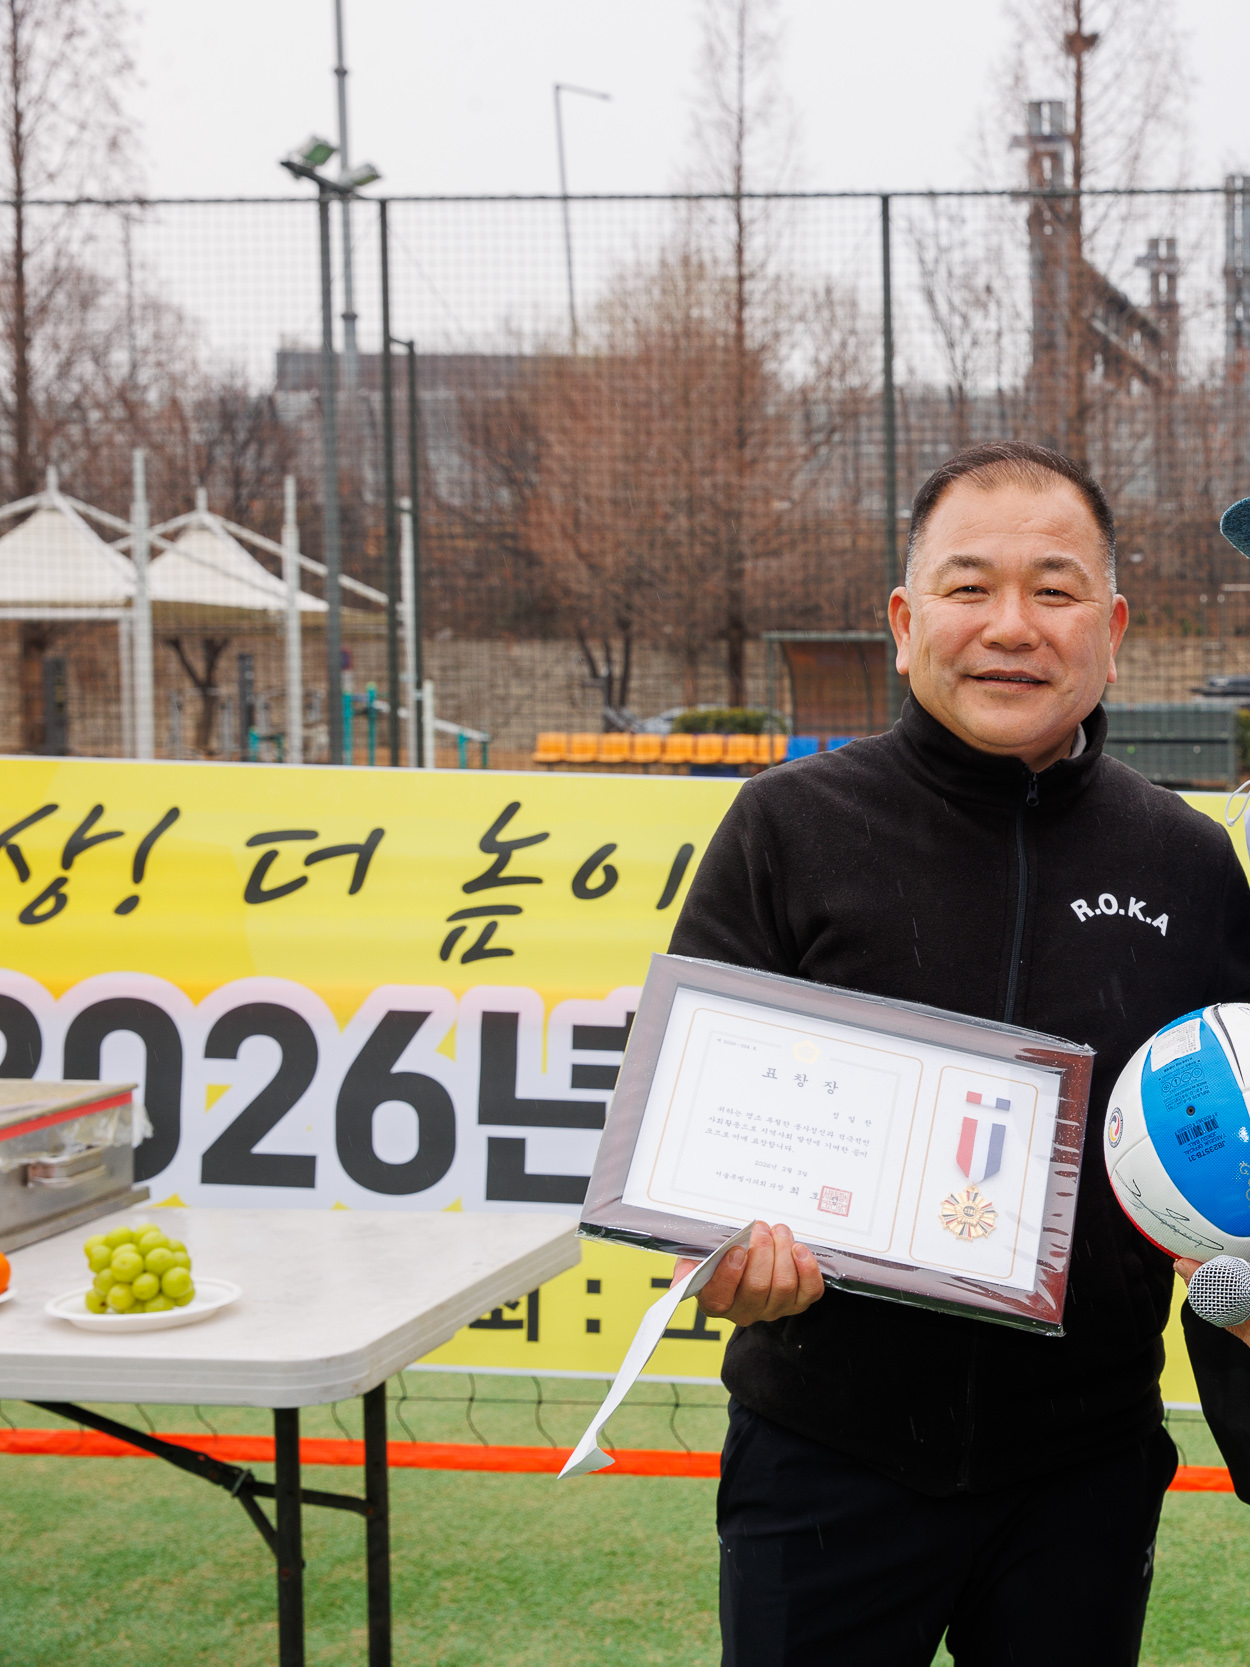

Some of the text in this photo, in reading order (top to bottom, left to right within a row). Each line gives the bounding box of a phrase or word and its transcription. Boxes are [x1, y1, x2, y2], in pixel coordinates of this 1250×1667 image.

[244, 828, 385, 904] 더
[439, 801, 695, 964] 높이
[1070, 893, 1169, 937] R.O.K.A
